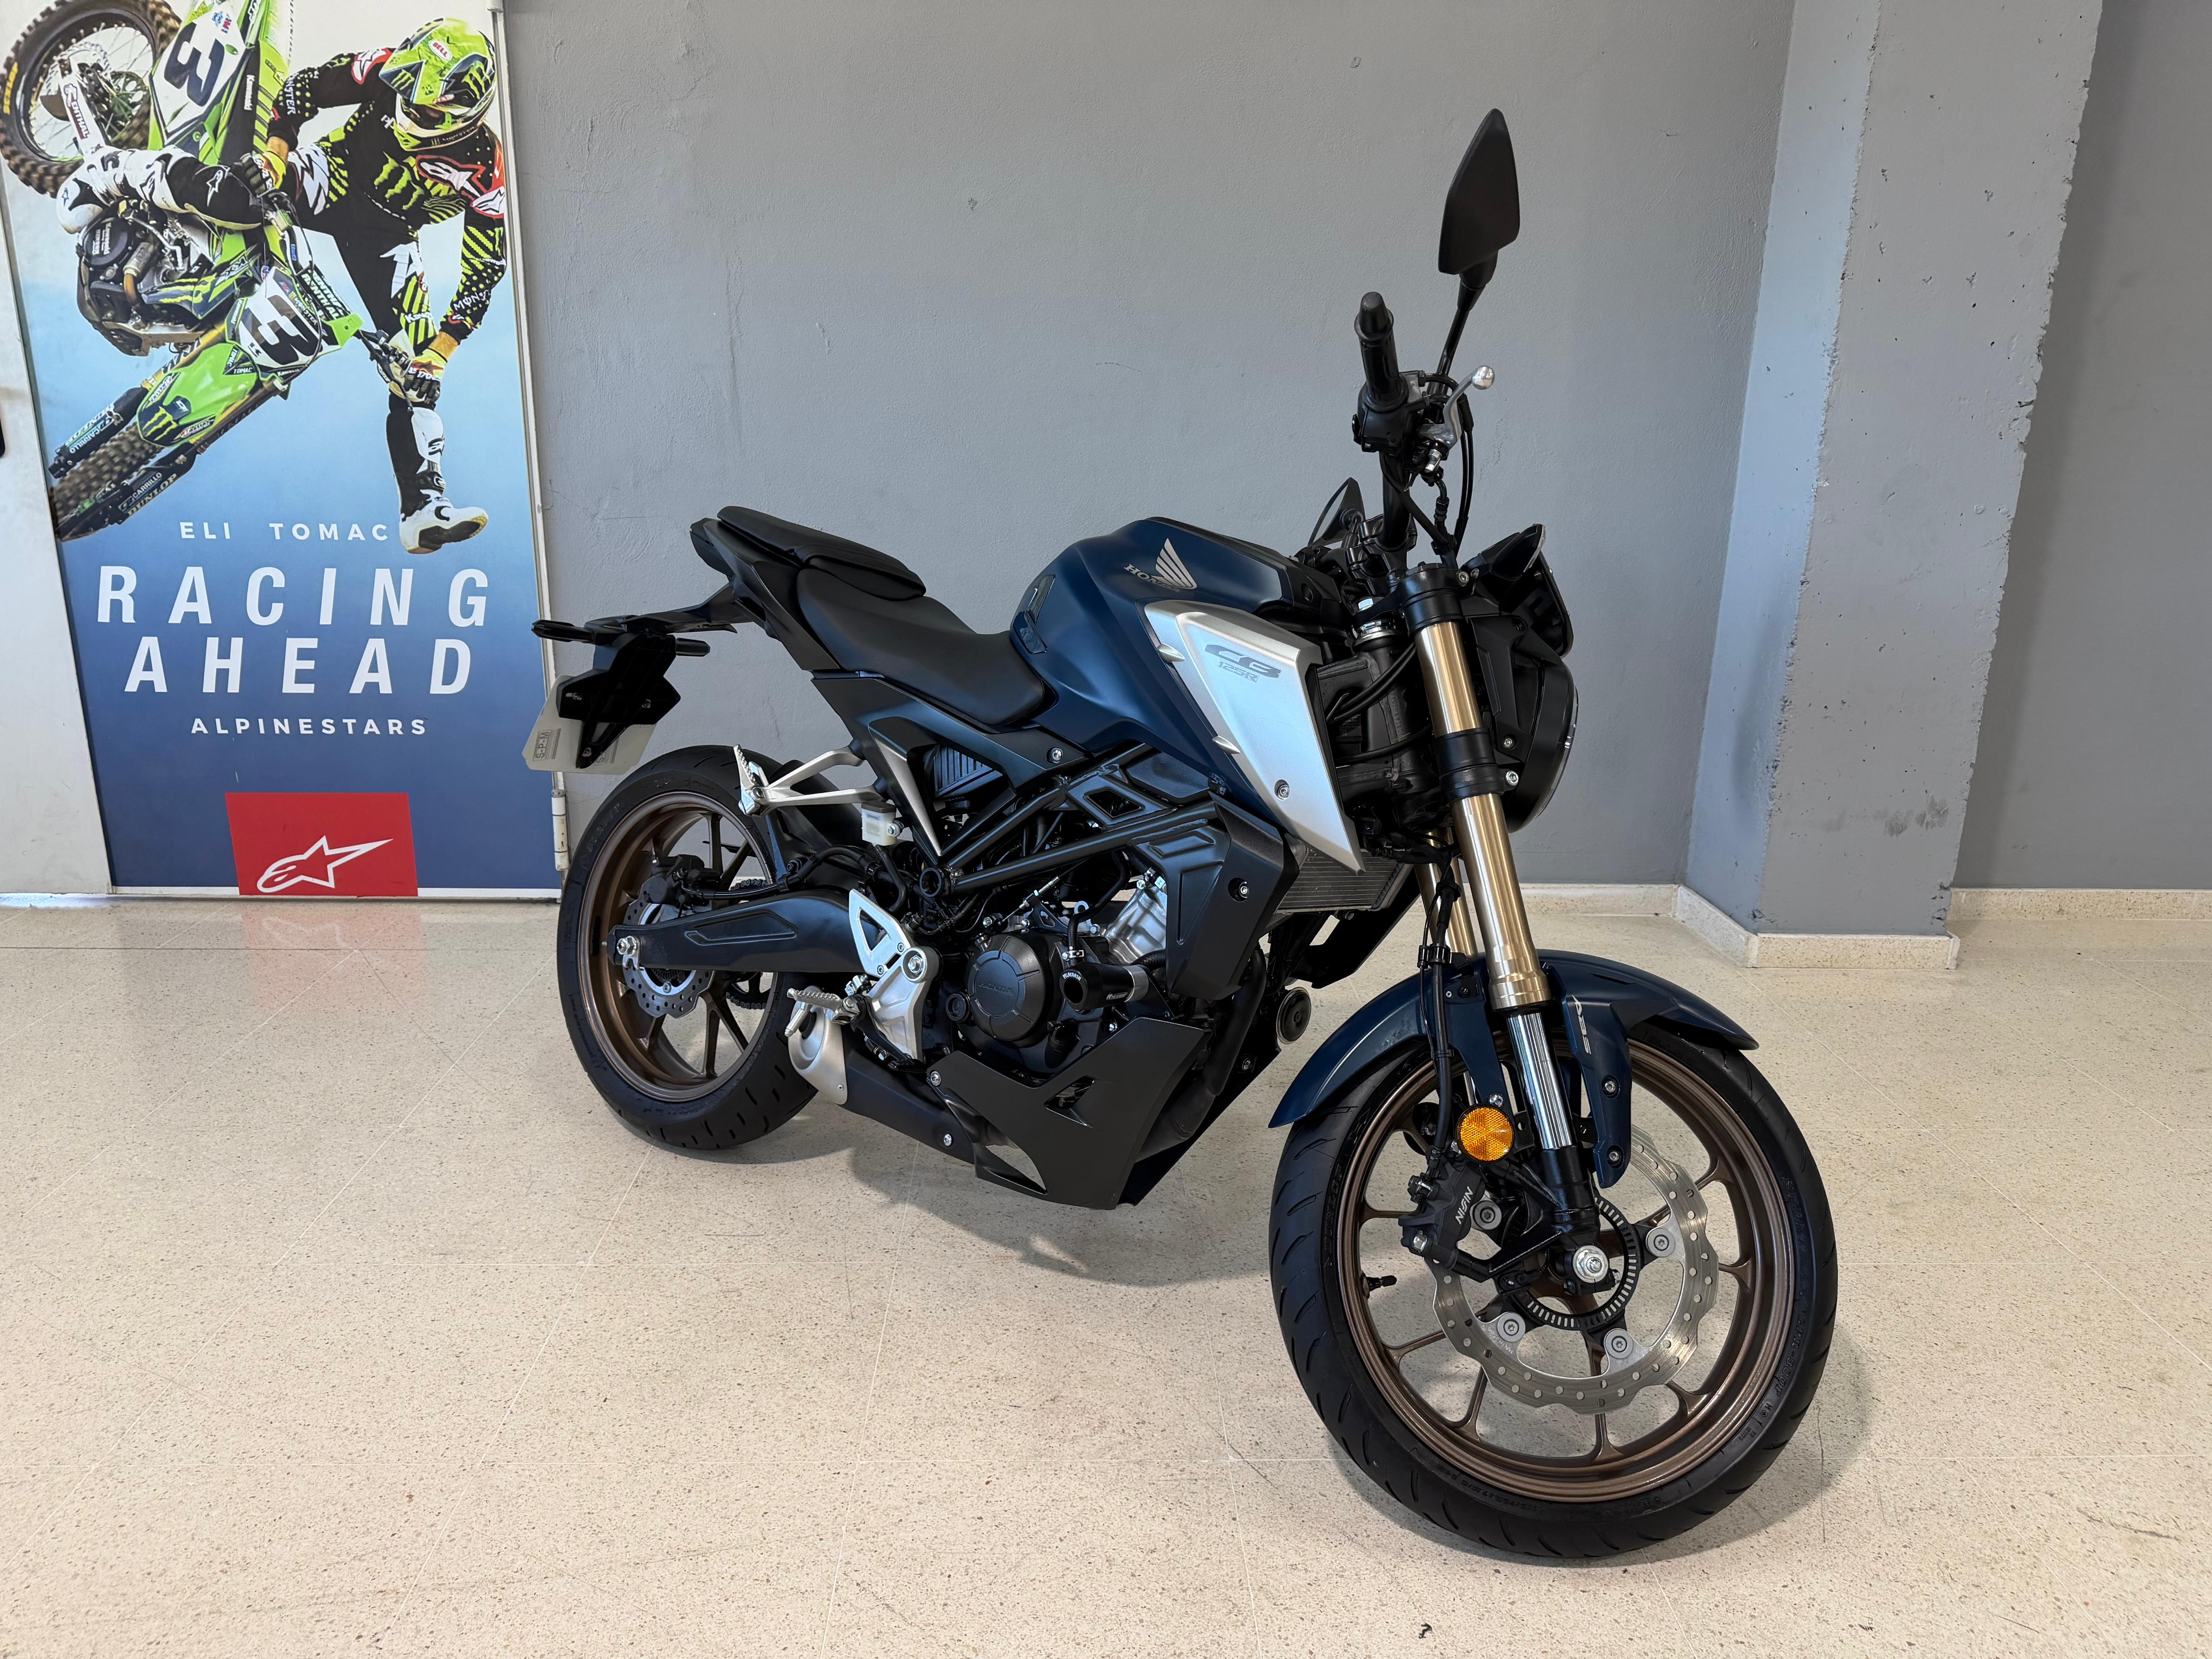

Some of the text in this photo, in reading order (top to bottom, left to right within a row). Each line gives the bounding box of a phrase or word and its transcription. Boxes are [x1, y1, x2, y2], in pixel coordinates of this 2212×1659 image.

[432, 42, 448, 57] BELL
[227, 349, 238, 367] TOMAC
[70, 429, 100, 454] CARRILLO
[128, 473, 177, 515] DUNLOP
[133, 473, 162, 497] CARRILLO
[180, 522, 388, 540] ELI TOMAC
[97, 566, 488, 626] RACING
[124, 636, 471, 694] AHEAD
[1205, 644, 1281, 678] CB
[1218, 661, 1258, 683] 125R
[191, 718, 426, 735] ALPINESTARS
[536, 732, 549, 759] S-P-M
[979, 980, 1014, 995] HONDA
[1571, 995, 1592, 1055] ABS
[1455, 1186, 1474, 1225] NISSIN
[1775, 1315, 1805, 1396] GPR-300F
